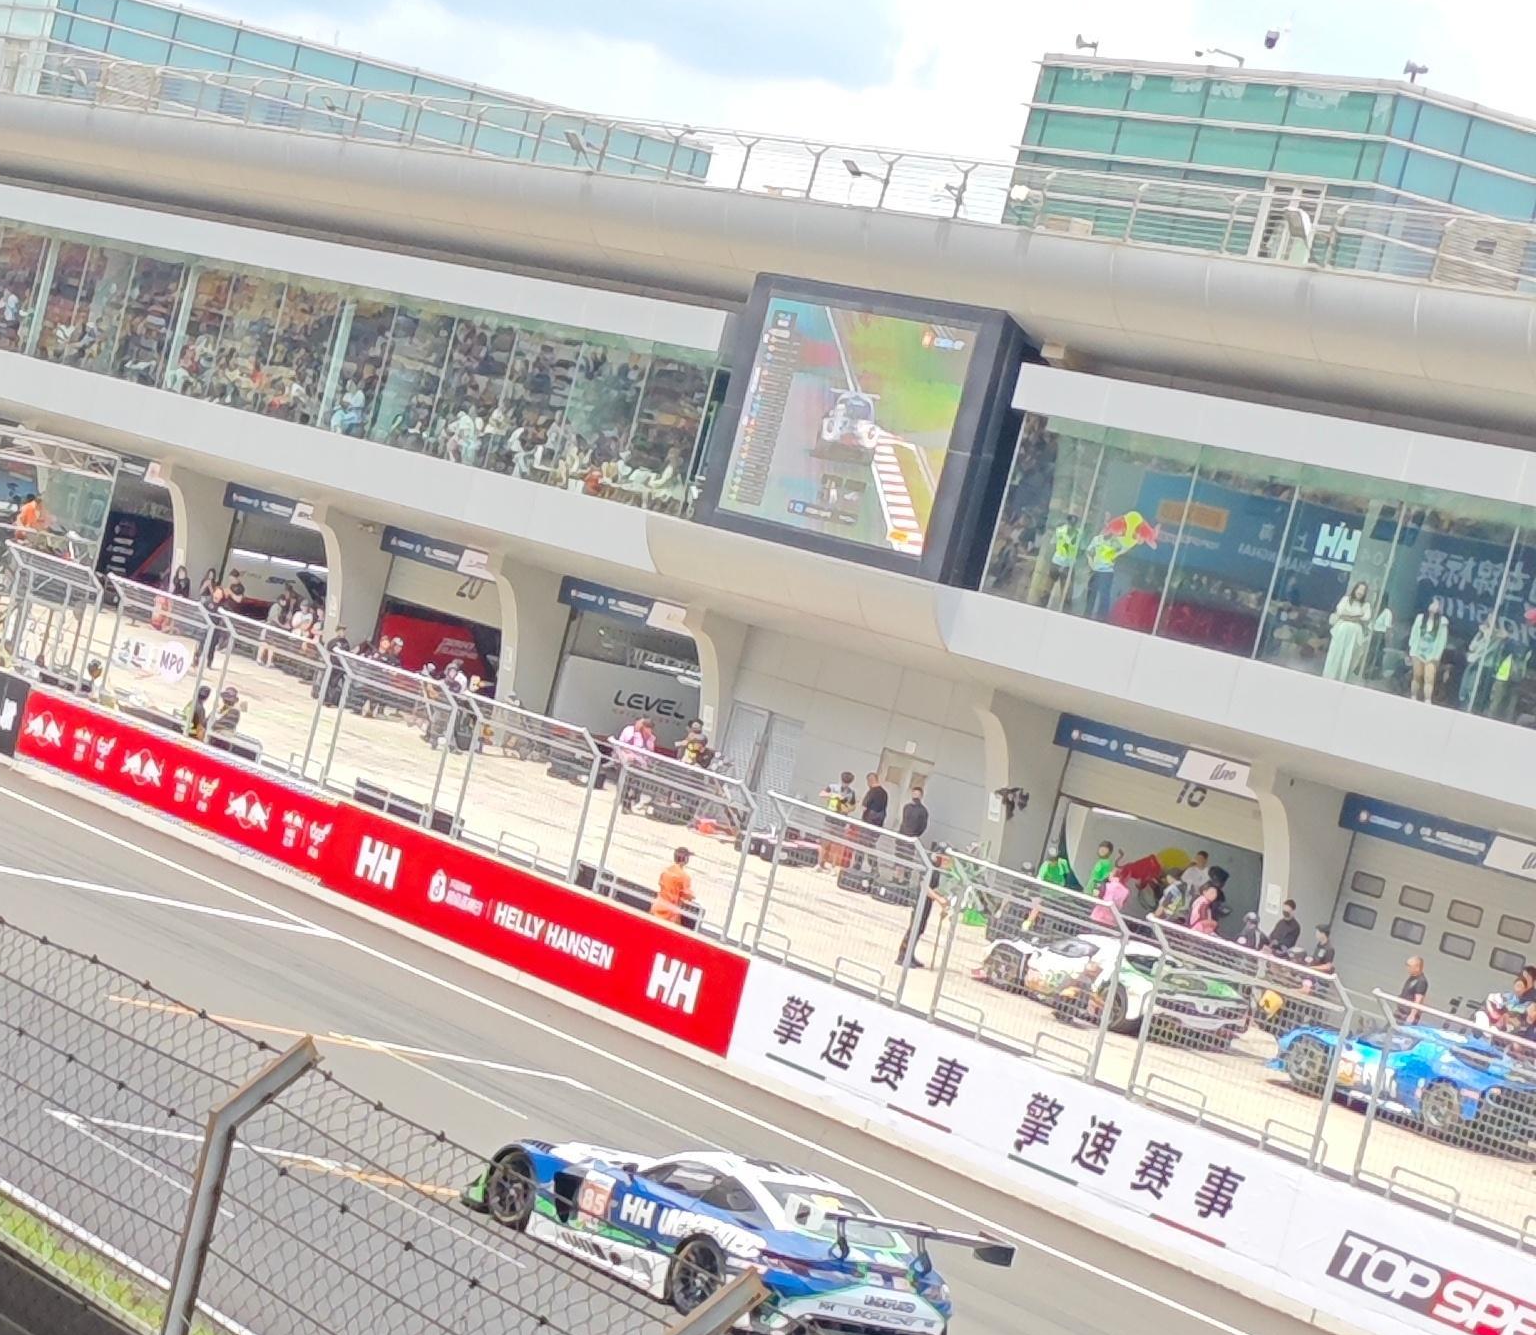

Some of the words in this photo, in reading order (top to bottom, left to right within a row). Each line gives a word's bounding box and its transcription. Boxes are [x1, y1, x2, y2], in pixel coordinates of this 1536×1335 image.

[613, 689, 686, 720] LEVEL
[354, 835, 402, 890] HH
[493, 901, 545, 940] HELLY
[544, 921, 615, 970] HANSEN
[646, 951, 704, 1015] HH
[773, 995, 969, 1107] 擎速赛事
[1015, 1092, 1246, 1220] 擎速赛事
[620, 1194, 656, 1229] HH
[1339, 1236, 1442, 1300] TOP
